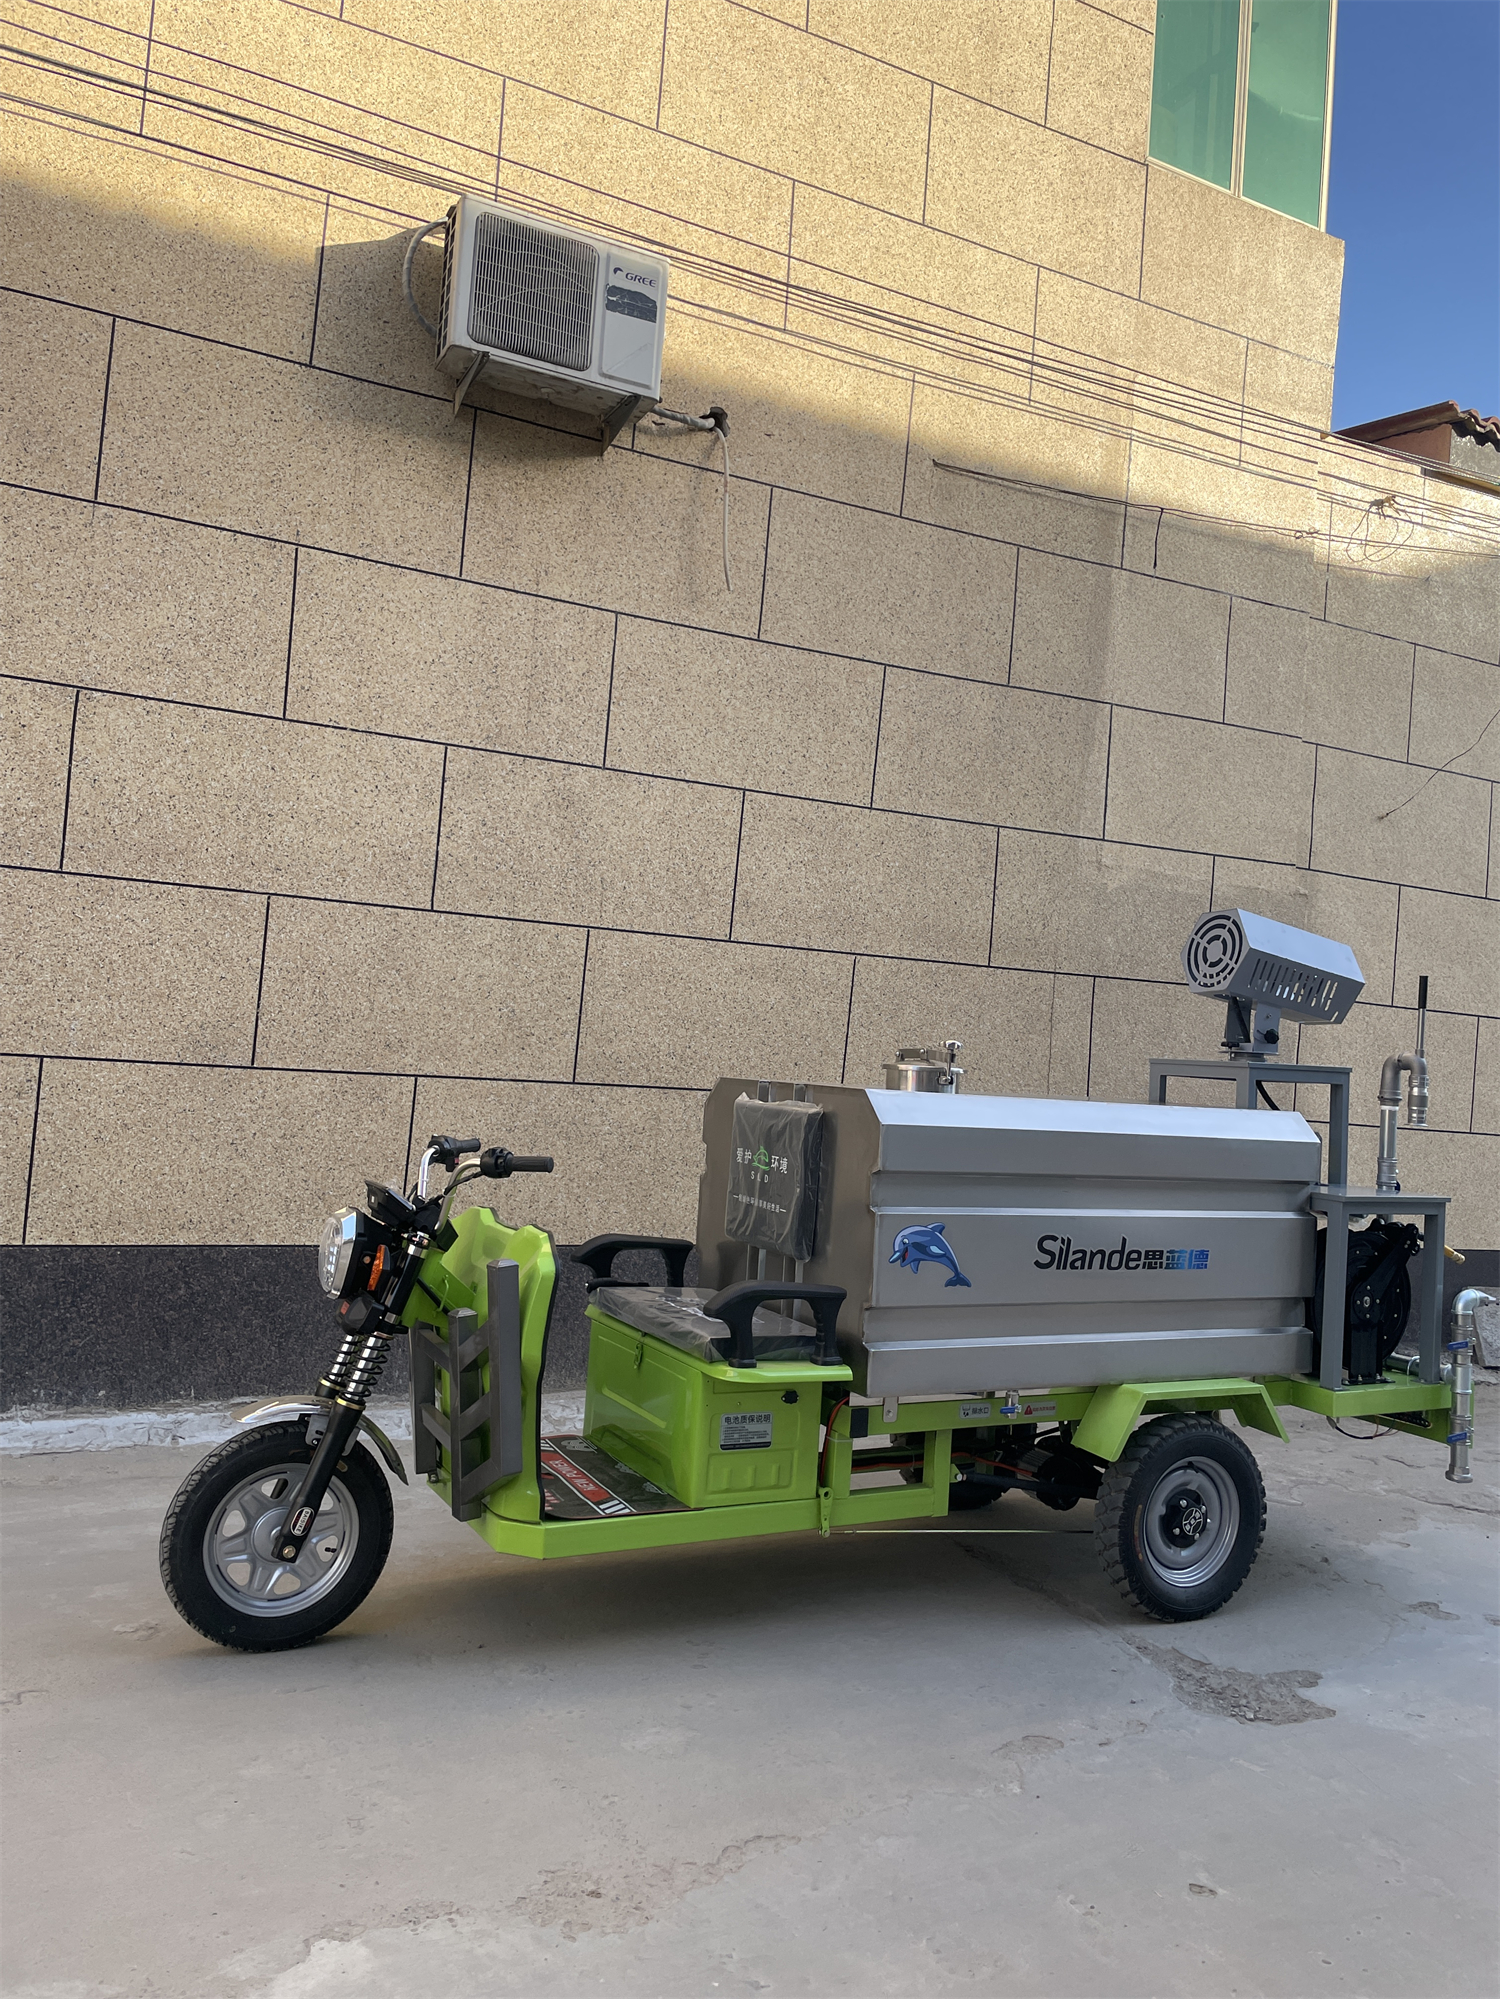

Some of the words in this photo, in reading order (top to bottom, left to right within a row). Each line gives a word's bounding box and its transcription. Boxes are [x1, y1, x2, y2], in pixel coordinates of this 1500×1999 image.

[625, 272, 657, 288] GREE
[771, 1155, 788, 1174] 环境
[750, 1170, 769, 1183] SLD
[1034, 1234, 1142, 1271] Silande
[1142, 1249, 1210, 1270] 思蓝德
[724, 1413, 771, 1425] 电池质保说明
[549, 1459, 582, 1478] POWER
[571, 1478, 599, 1491] NEW
